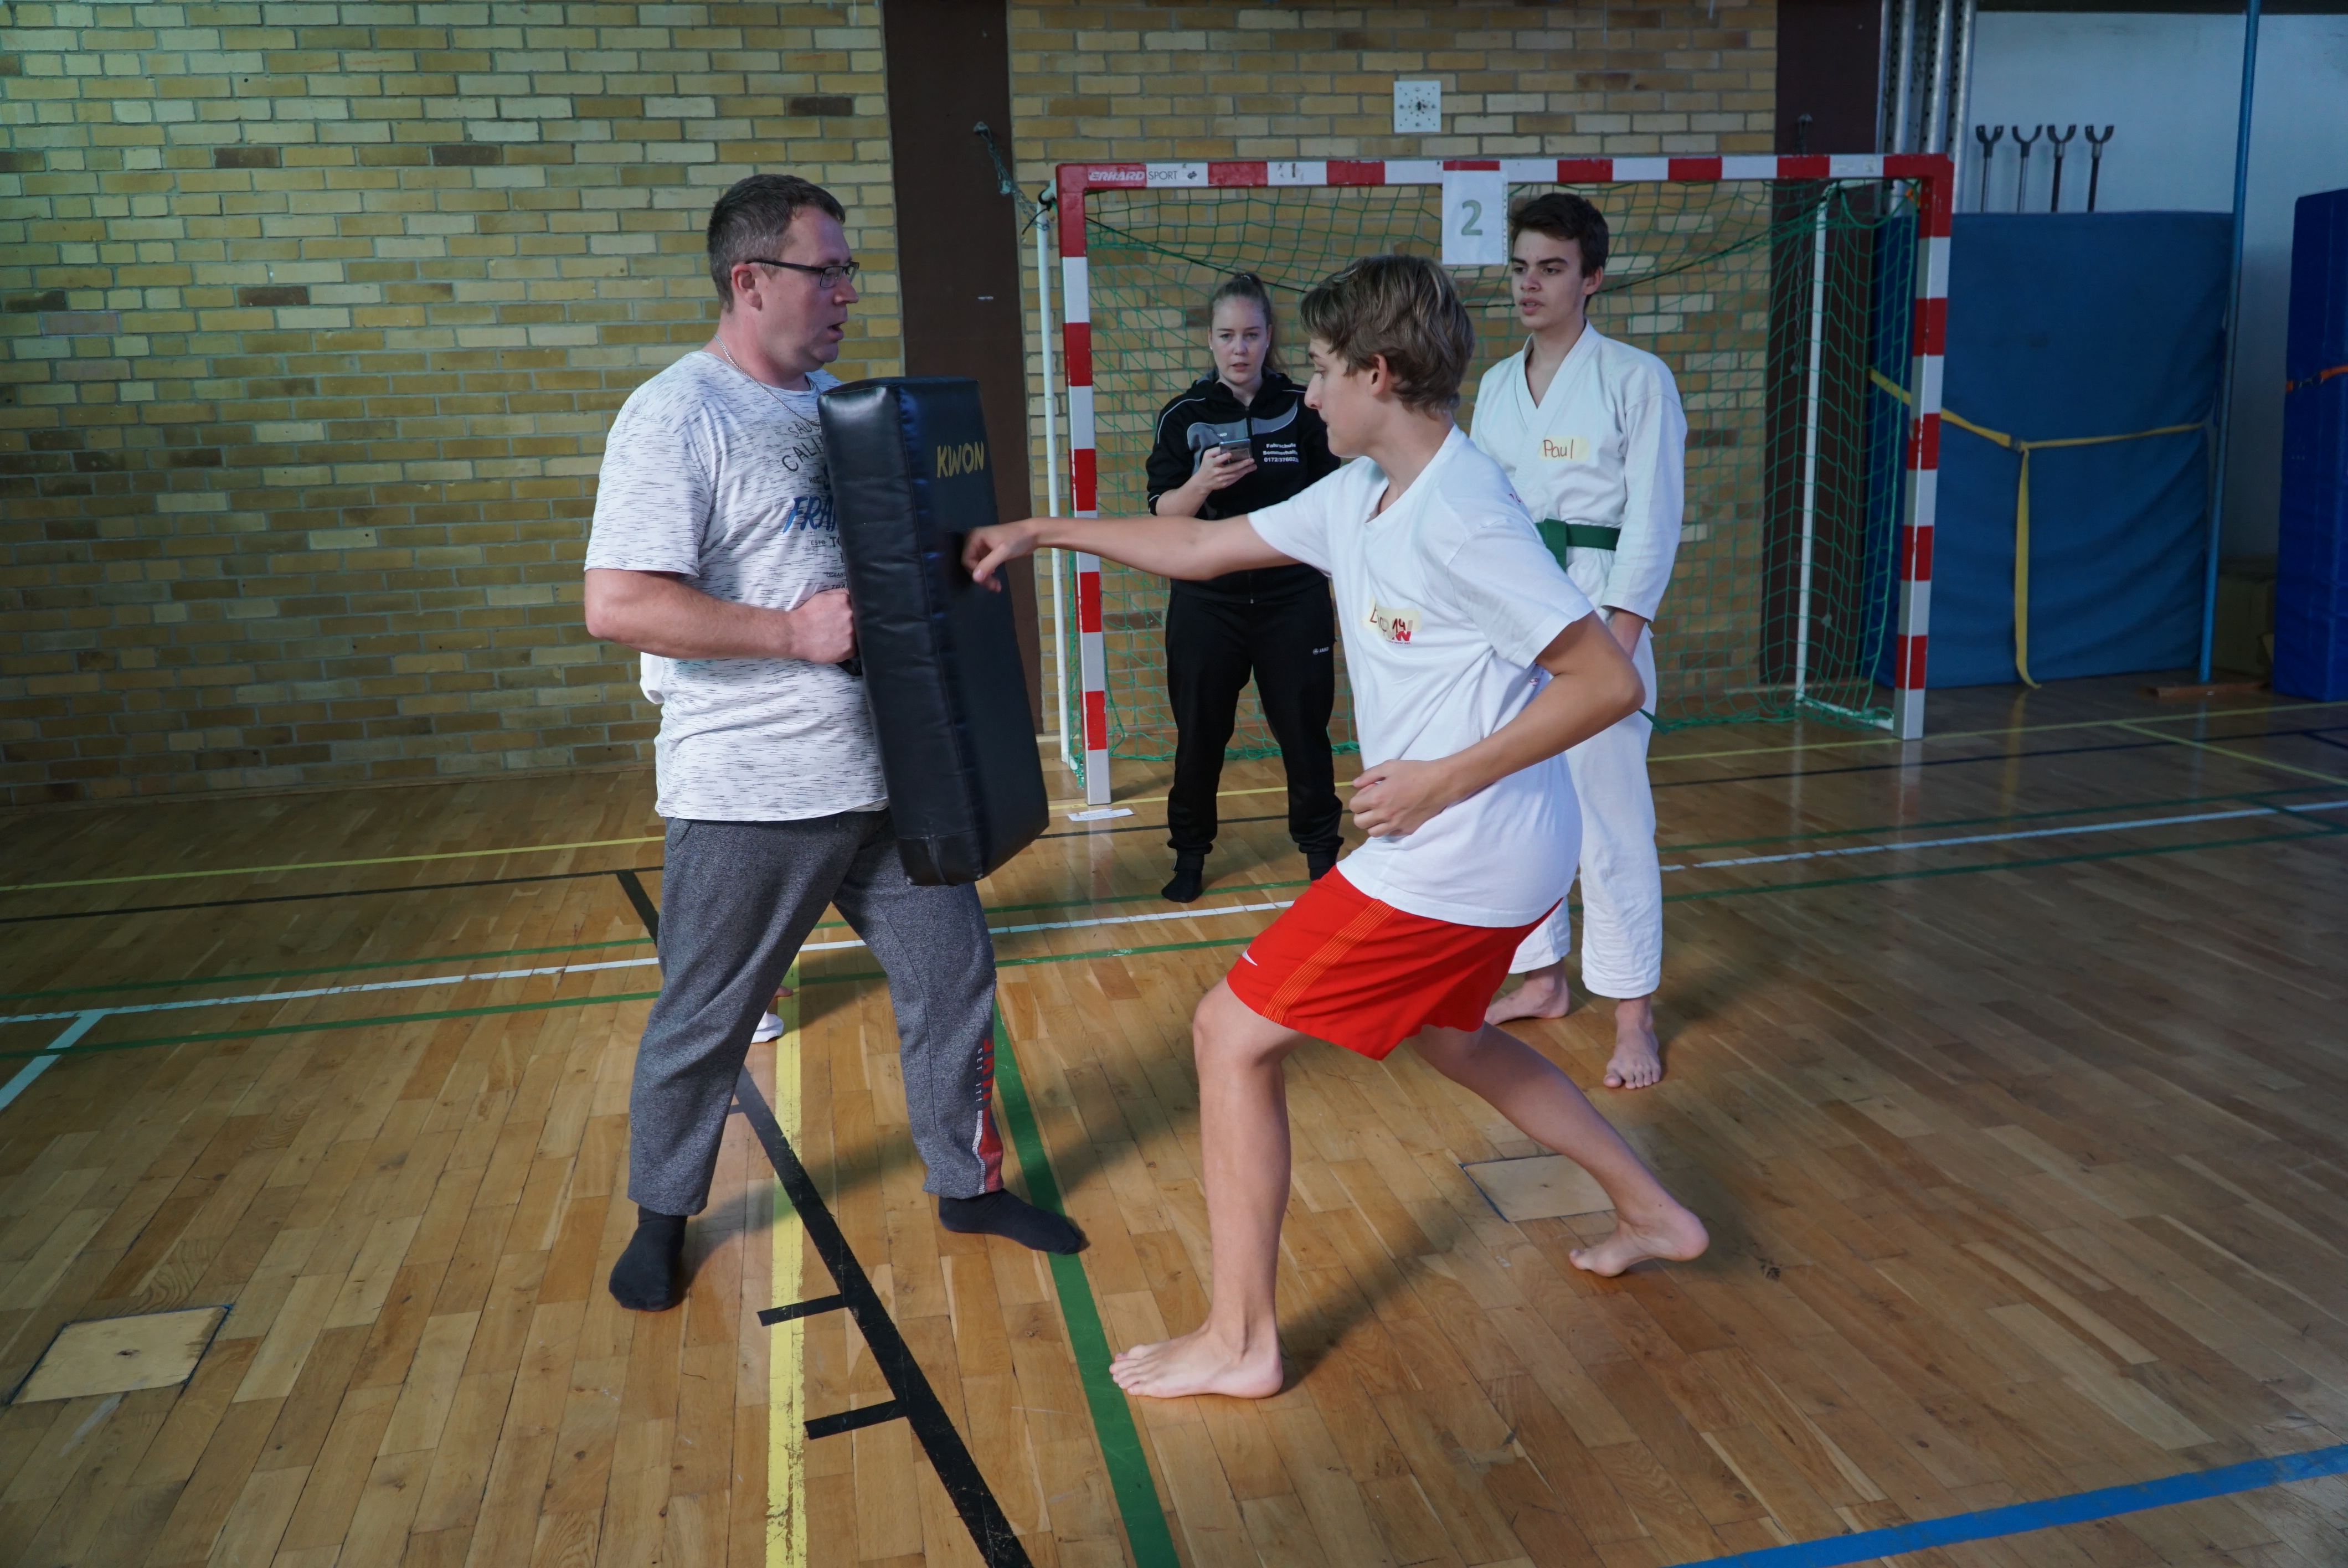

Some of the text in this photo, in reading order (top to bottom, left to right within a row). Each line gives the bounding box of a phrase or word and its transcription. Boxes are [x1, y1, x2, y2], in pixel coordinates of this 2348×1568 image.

[1089, 171, 1145, 182] ERHARD
[1148, 171, 1178, 180] SPORT
[1461, 200, 1483, 236] 2
[782, 436, 823, 472] CALI
[936, 440, 985, 478] KWON
[1542, 439, 1574, 460] Paul
